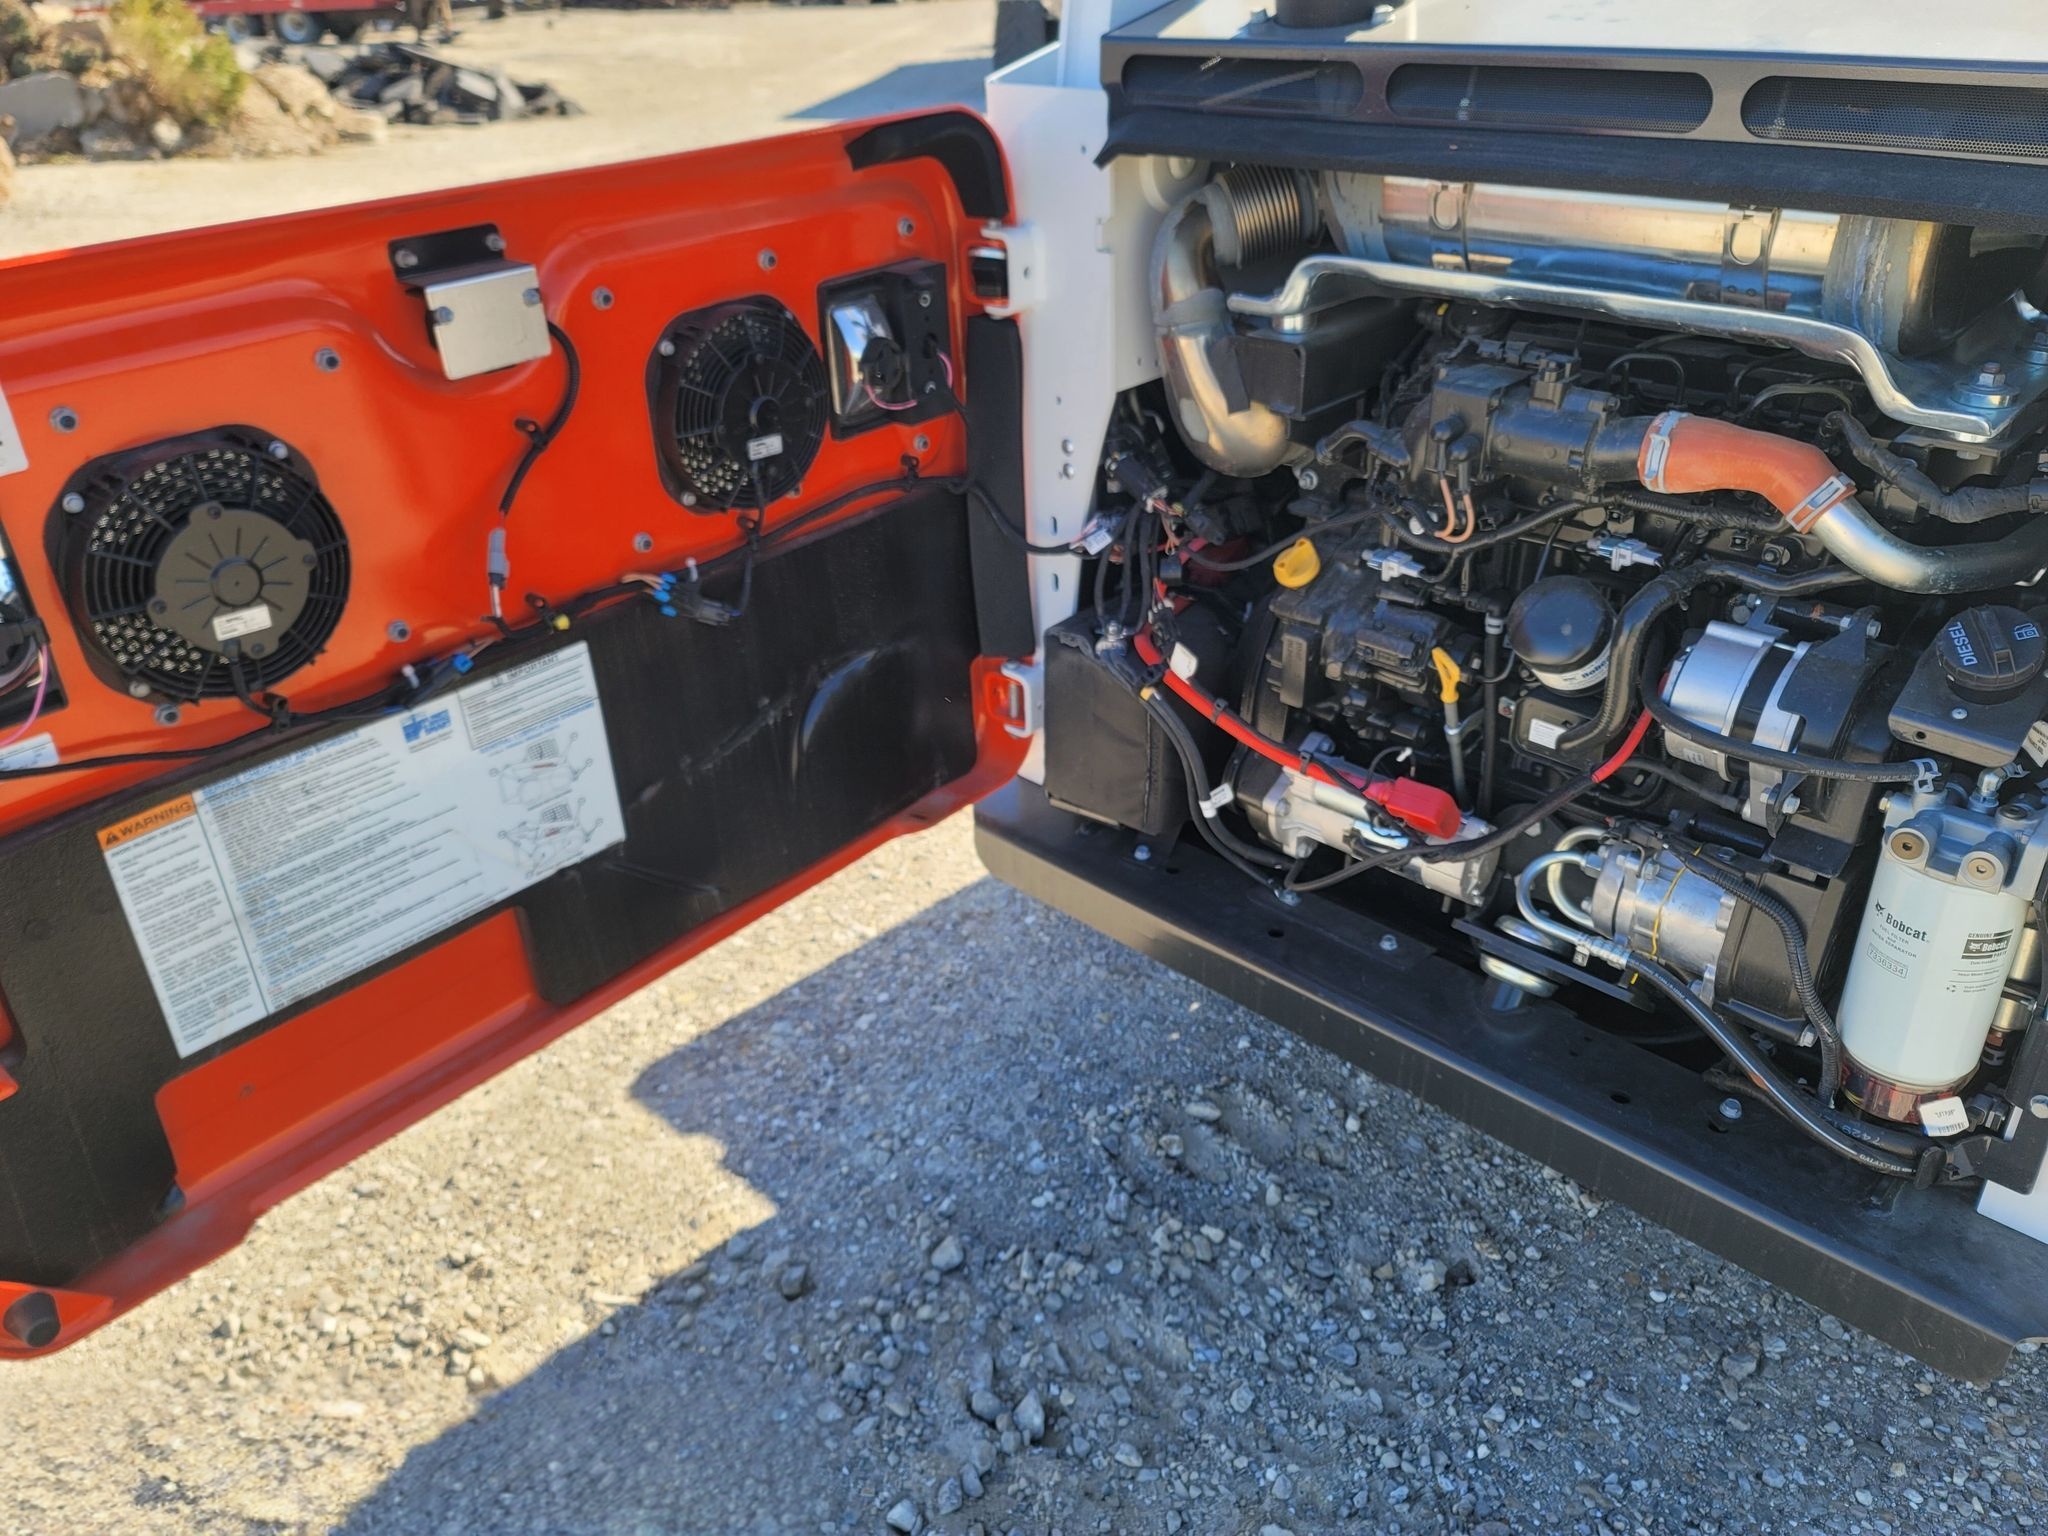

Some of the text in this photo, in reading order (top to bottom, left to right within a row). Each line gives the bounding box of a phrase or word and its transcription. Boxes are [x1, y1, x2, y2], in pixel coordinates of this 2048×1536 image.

[1949, 621, 1978, 667] DIESEL
[119, 801, 192, 837] WARNING
[1886, 912, 1928, 942] Bobcat
[1982, 940, 2007, 952] Bobcat
